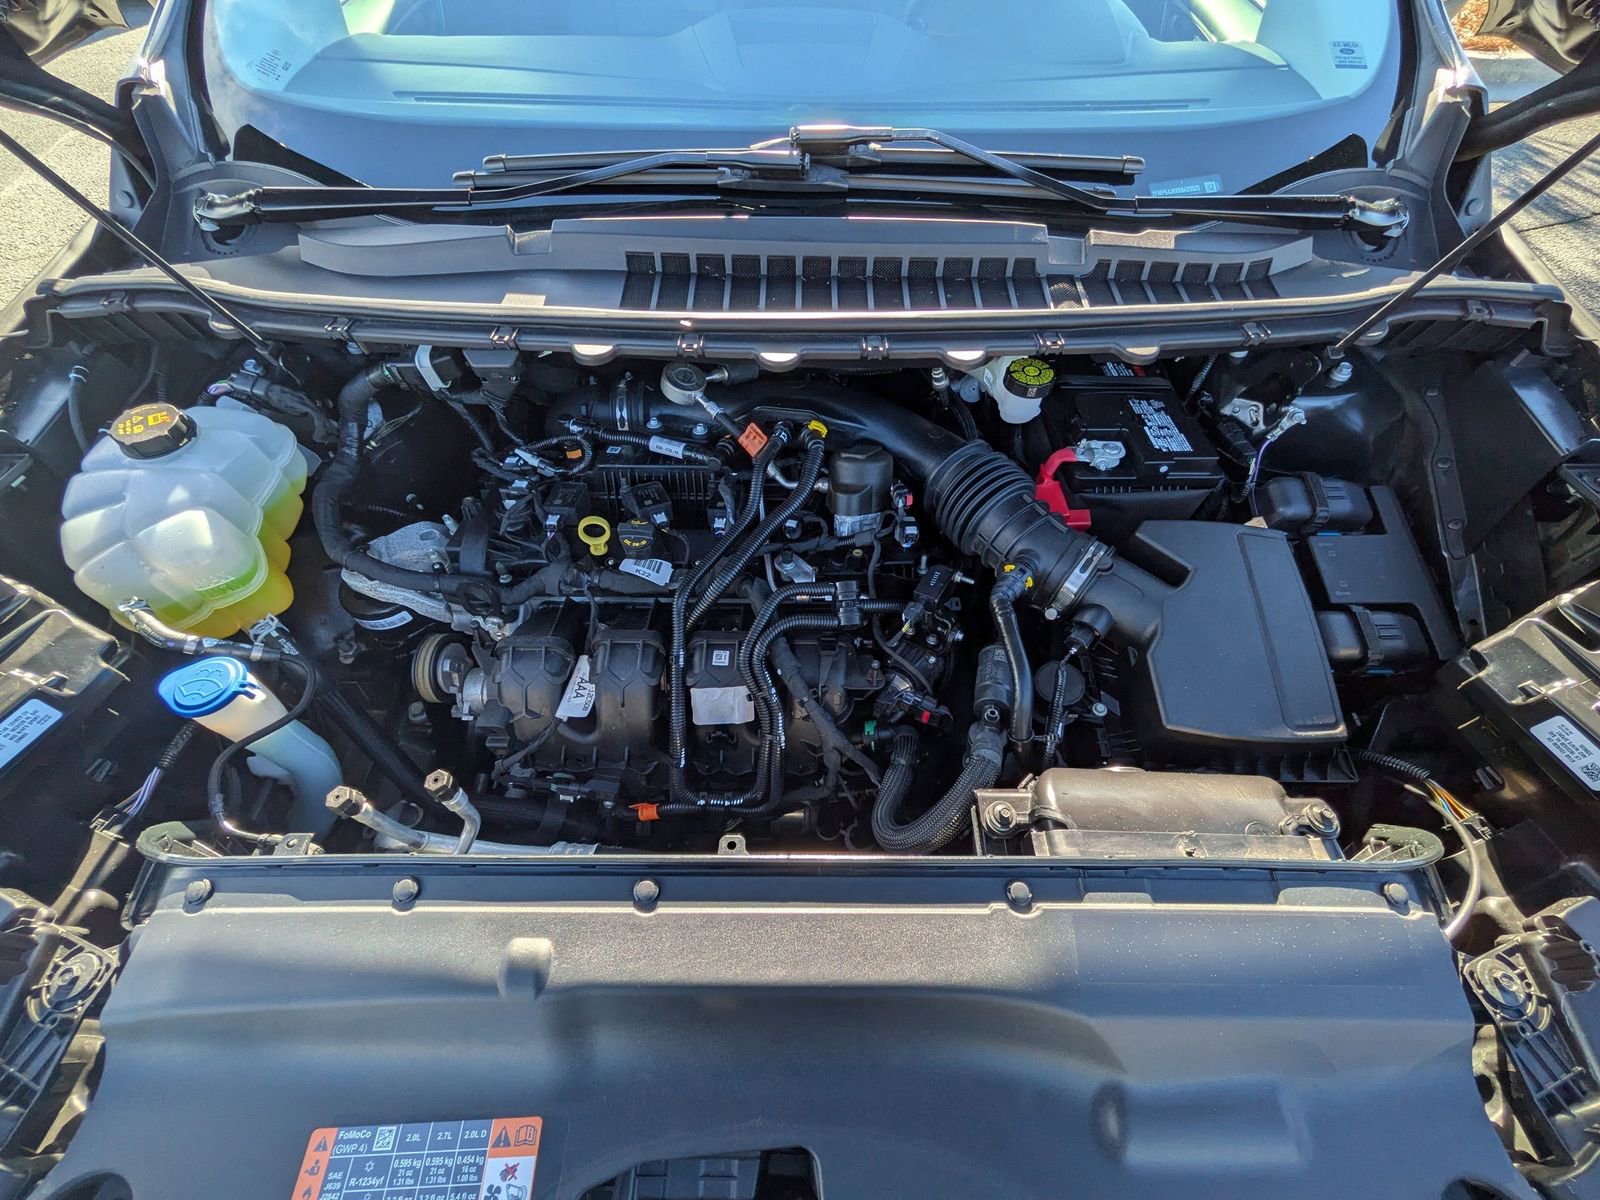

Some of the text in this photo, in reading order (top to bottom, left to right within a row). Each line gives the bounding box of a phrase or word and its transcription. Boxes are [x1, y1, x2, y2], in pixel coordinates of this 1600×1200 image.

[635, 568, 651, 578] K22
[573, 677, 589, 698] AAA
[338, 1130, 371, 1140] FoMoCo
[406, 1134, 421, 1142] 2.0L
[437, 1132, 452, 1140] 2.7L
[333, 1144, 368, 1156] (GWP 4)
[394, 1159, 421, 1168] 0.595 kg
[426, 1157, 453, 1166] 0.595 kg
[457, 1156, 484, 1165] 0.454 kg
